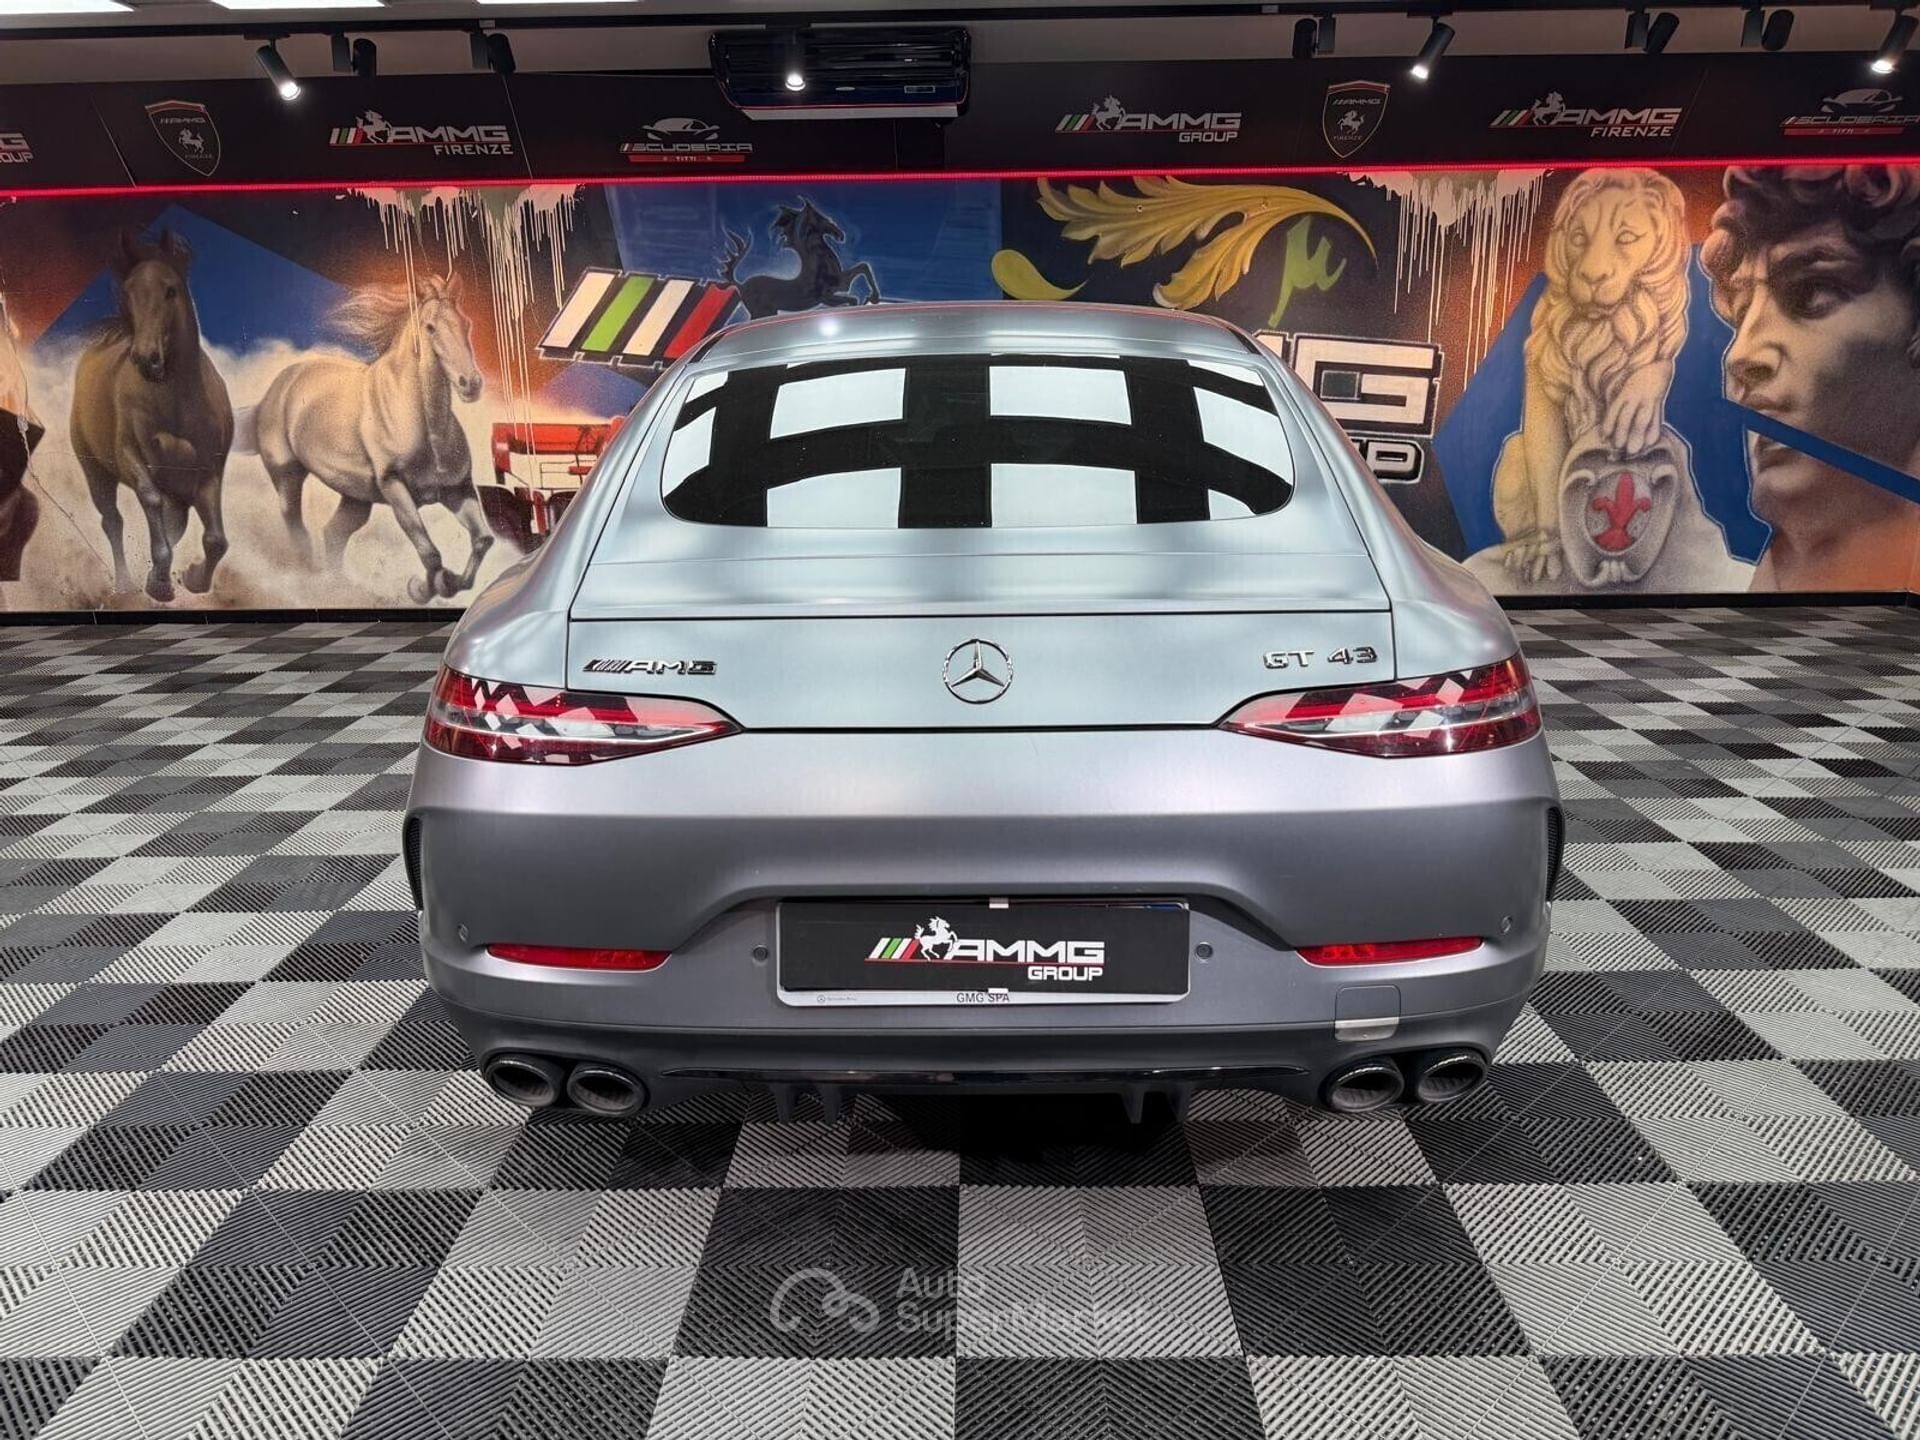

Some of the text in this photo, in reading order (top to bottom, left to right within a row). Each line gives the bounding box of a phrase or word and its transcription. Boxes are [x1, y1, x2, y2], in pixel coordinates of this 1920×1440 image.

[1114, 112, 1242, 130] AMMG
[1549, 107, 1683, 125] AMMG
[386, 125, 511, 143] AMMG
[1178, 131, 1239, 143] GROUP
[1590, 126, 1675, 138] FIRENZE
[0, 151, 34, 163] OUP
[433, 144, 514, 155] FIRENZE
[1262, 645, 1378, 669] GT 43
[622, 659, 718, 676] AMG
[943, 939, 1105, 964] AMMG
[1027, 966, 1104, 981] GROUP
[956, 992, 1010, 1003] GMG SPA
